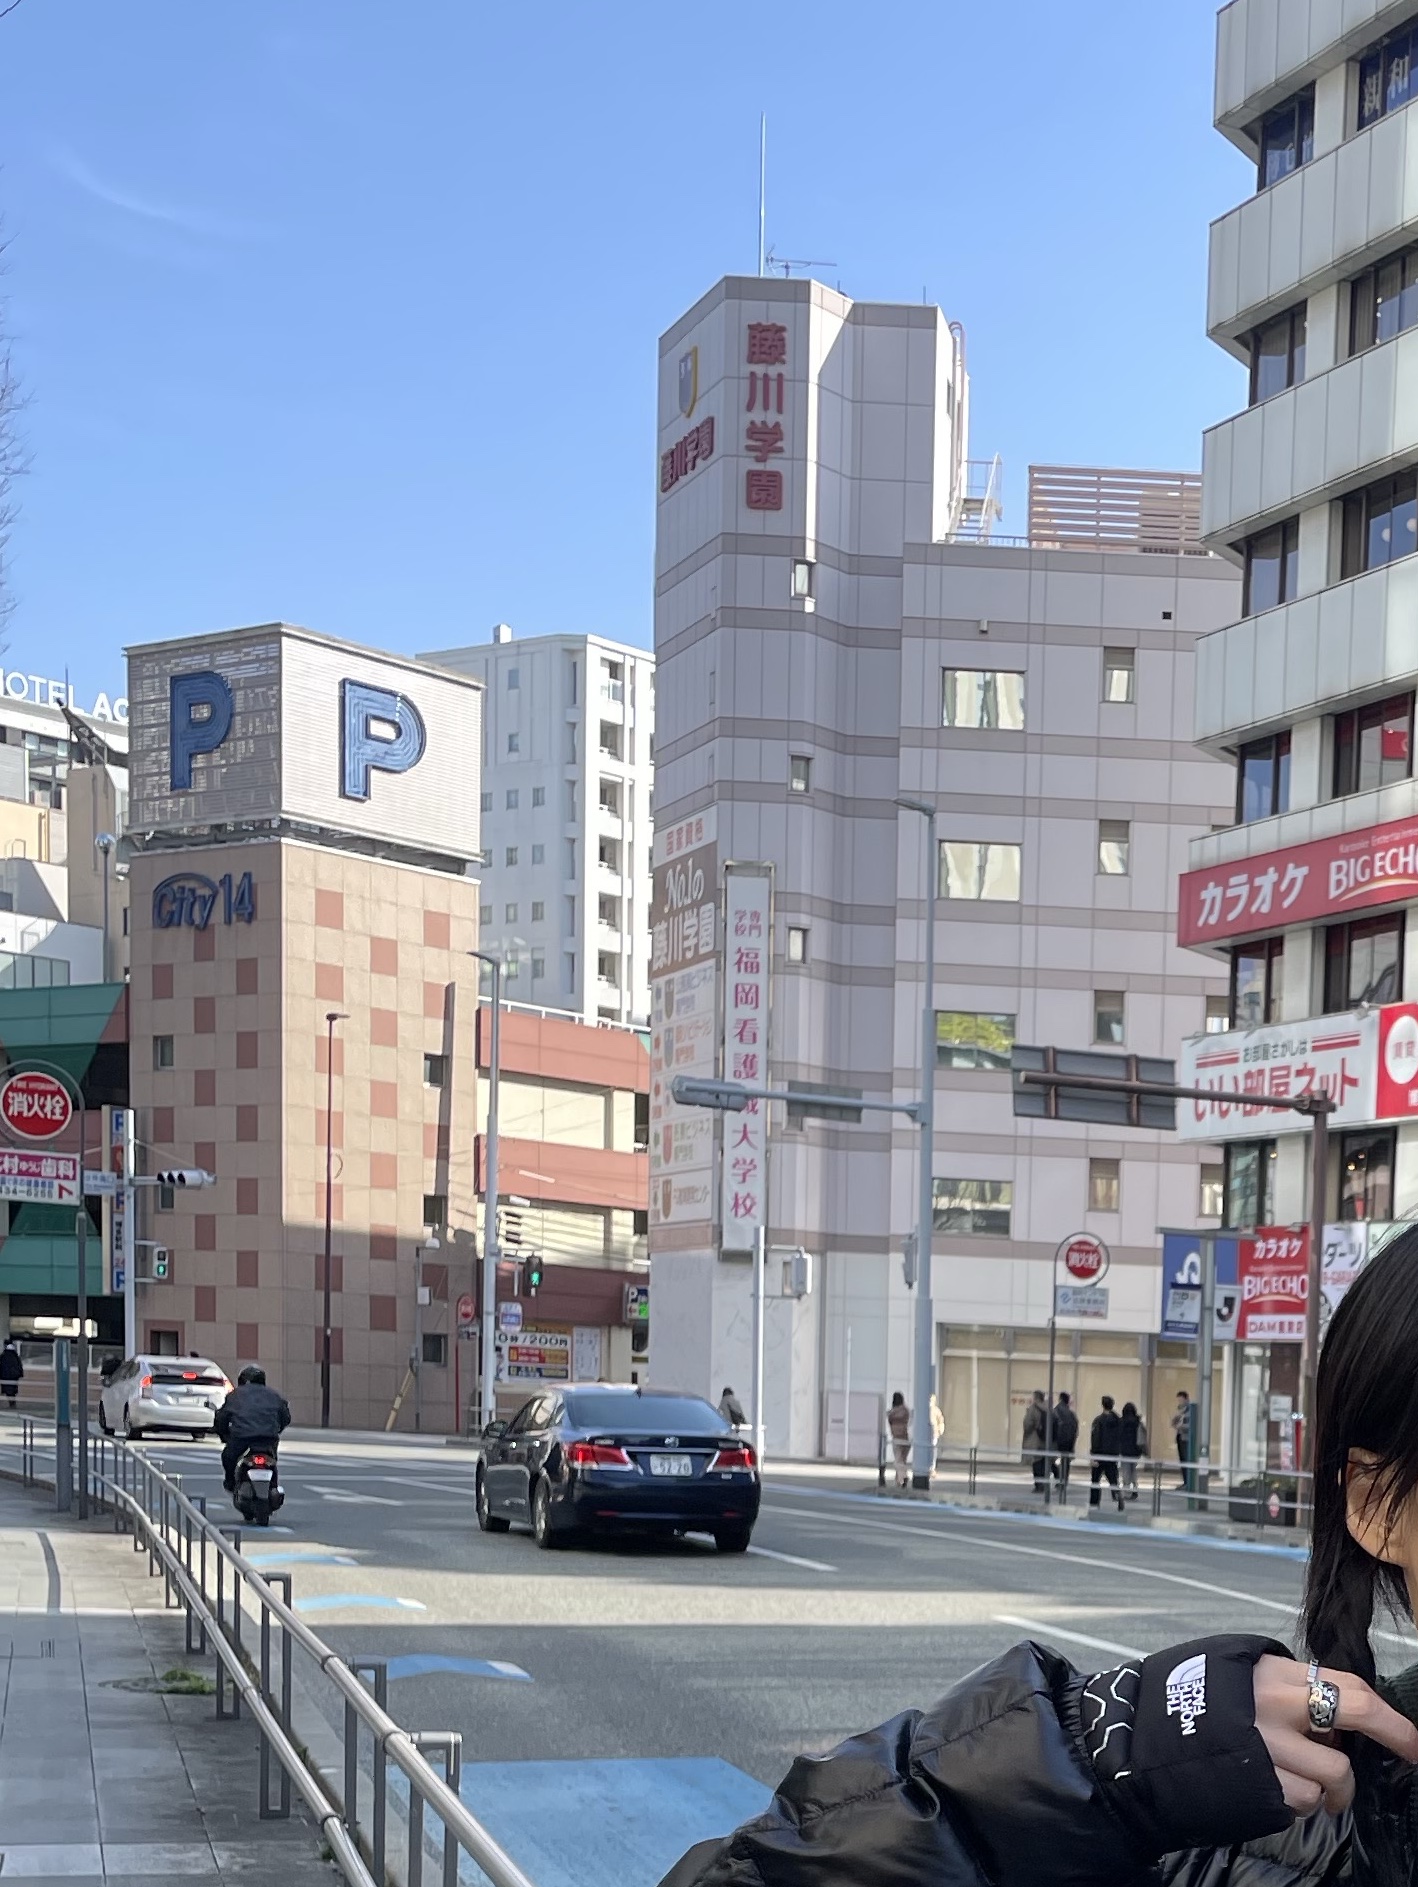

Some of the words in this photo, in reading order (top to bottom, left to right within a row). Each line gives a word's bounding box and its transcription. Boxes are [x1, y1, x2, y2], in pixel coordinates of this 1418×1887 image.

[744, 322, 787, 511] 藤川学園
[170, 671, 234, 791] P
[340, 677, 427, 800] P
[153, 876, 219, 931] City
[219, 872, 252, 926] 14
[1197, 863, 1309, 928] カラオケ
[1328, 855, 1371, 900] BIG
[7, 1090, 66, 1121] 消火栓
[1253, 1237, 1303, 1260] カラオケ
[1243, 1275, 1269, 1301] BIG
[1167, 1684, 1181, 1716] THE
[1180, 1681, 1197, 1736] NORTH
[1191, 1677, 1207, 1716] FACE
